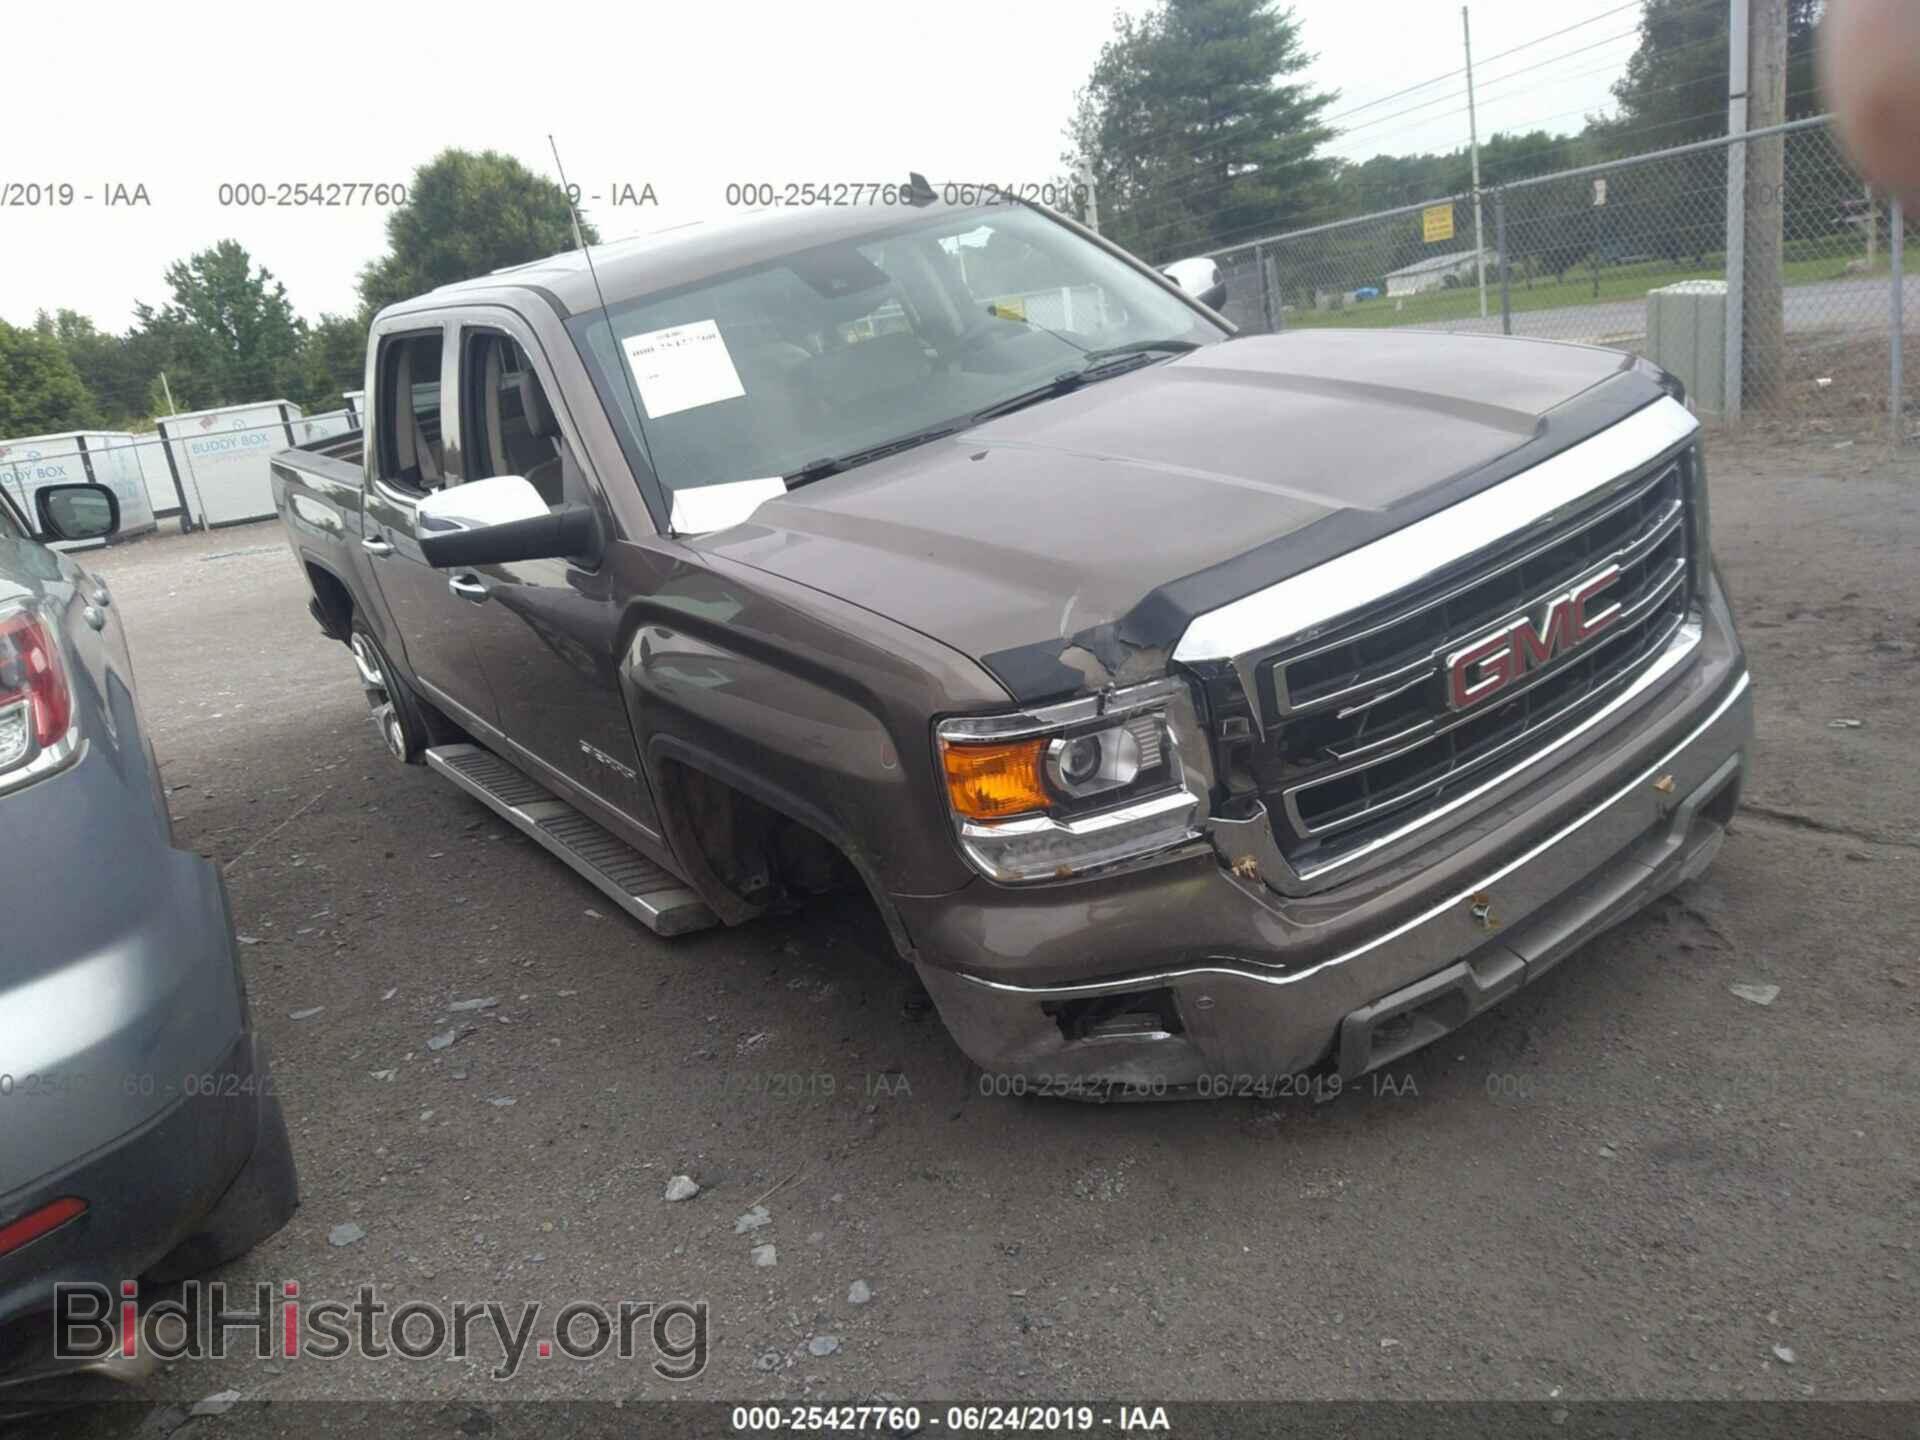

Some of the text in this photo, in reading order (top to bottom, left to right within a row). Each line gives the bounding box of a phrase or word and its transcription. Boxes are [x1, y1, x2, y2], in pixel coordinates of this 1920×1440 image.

[240, 432, 271, 448] BOX
[36, 464, 68, 479] BOX
[1447, 563, 1622, 712] GMC
